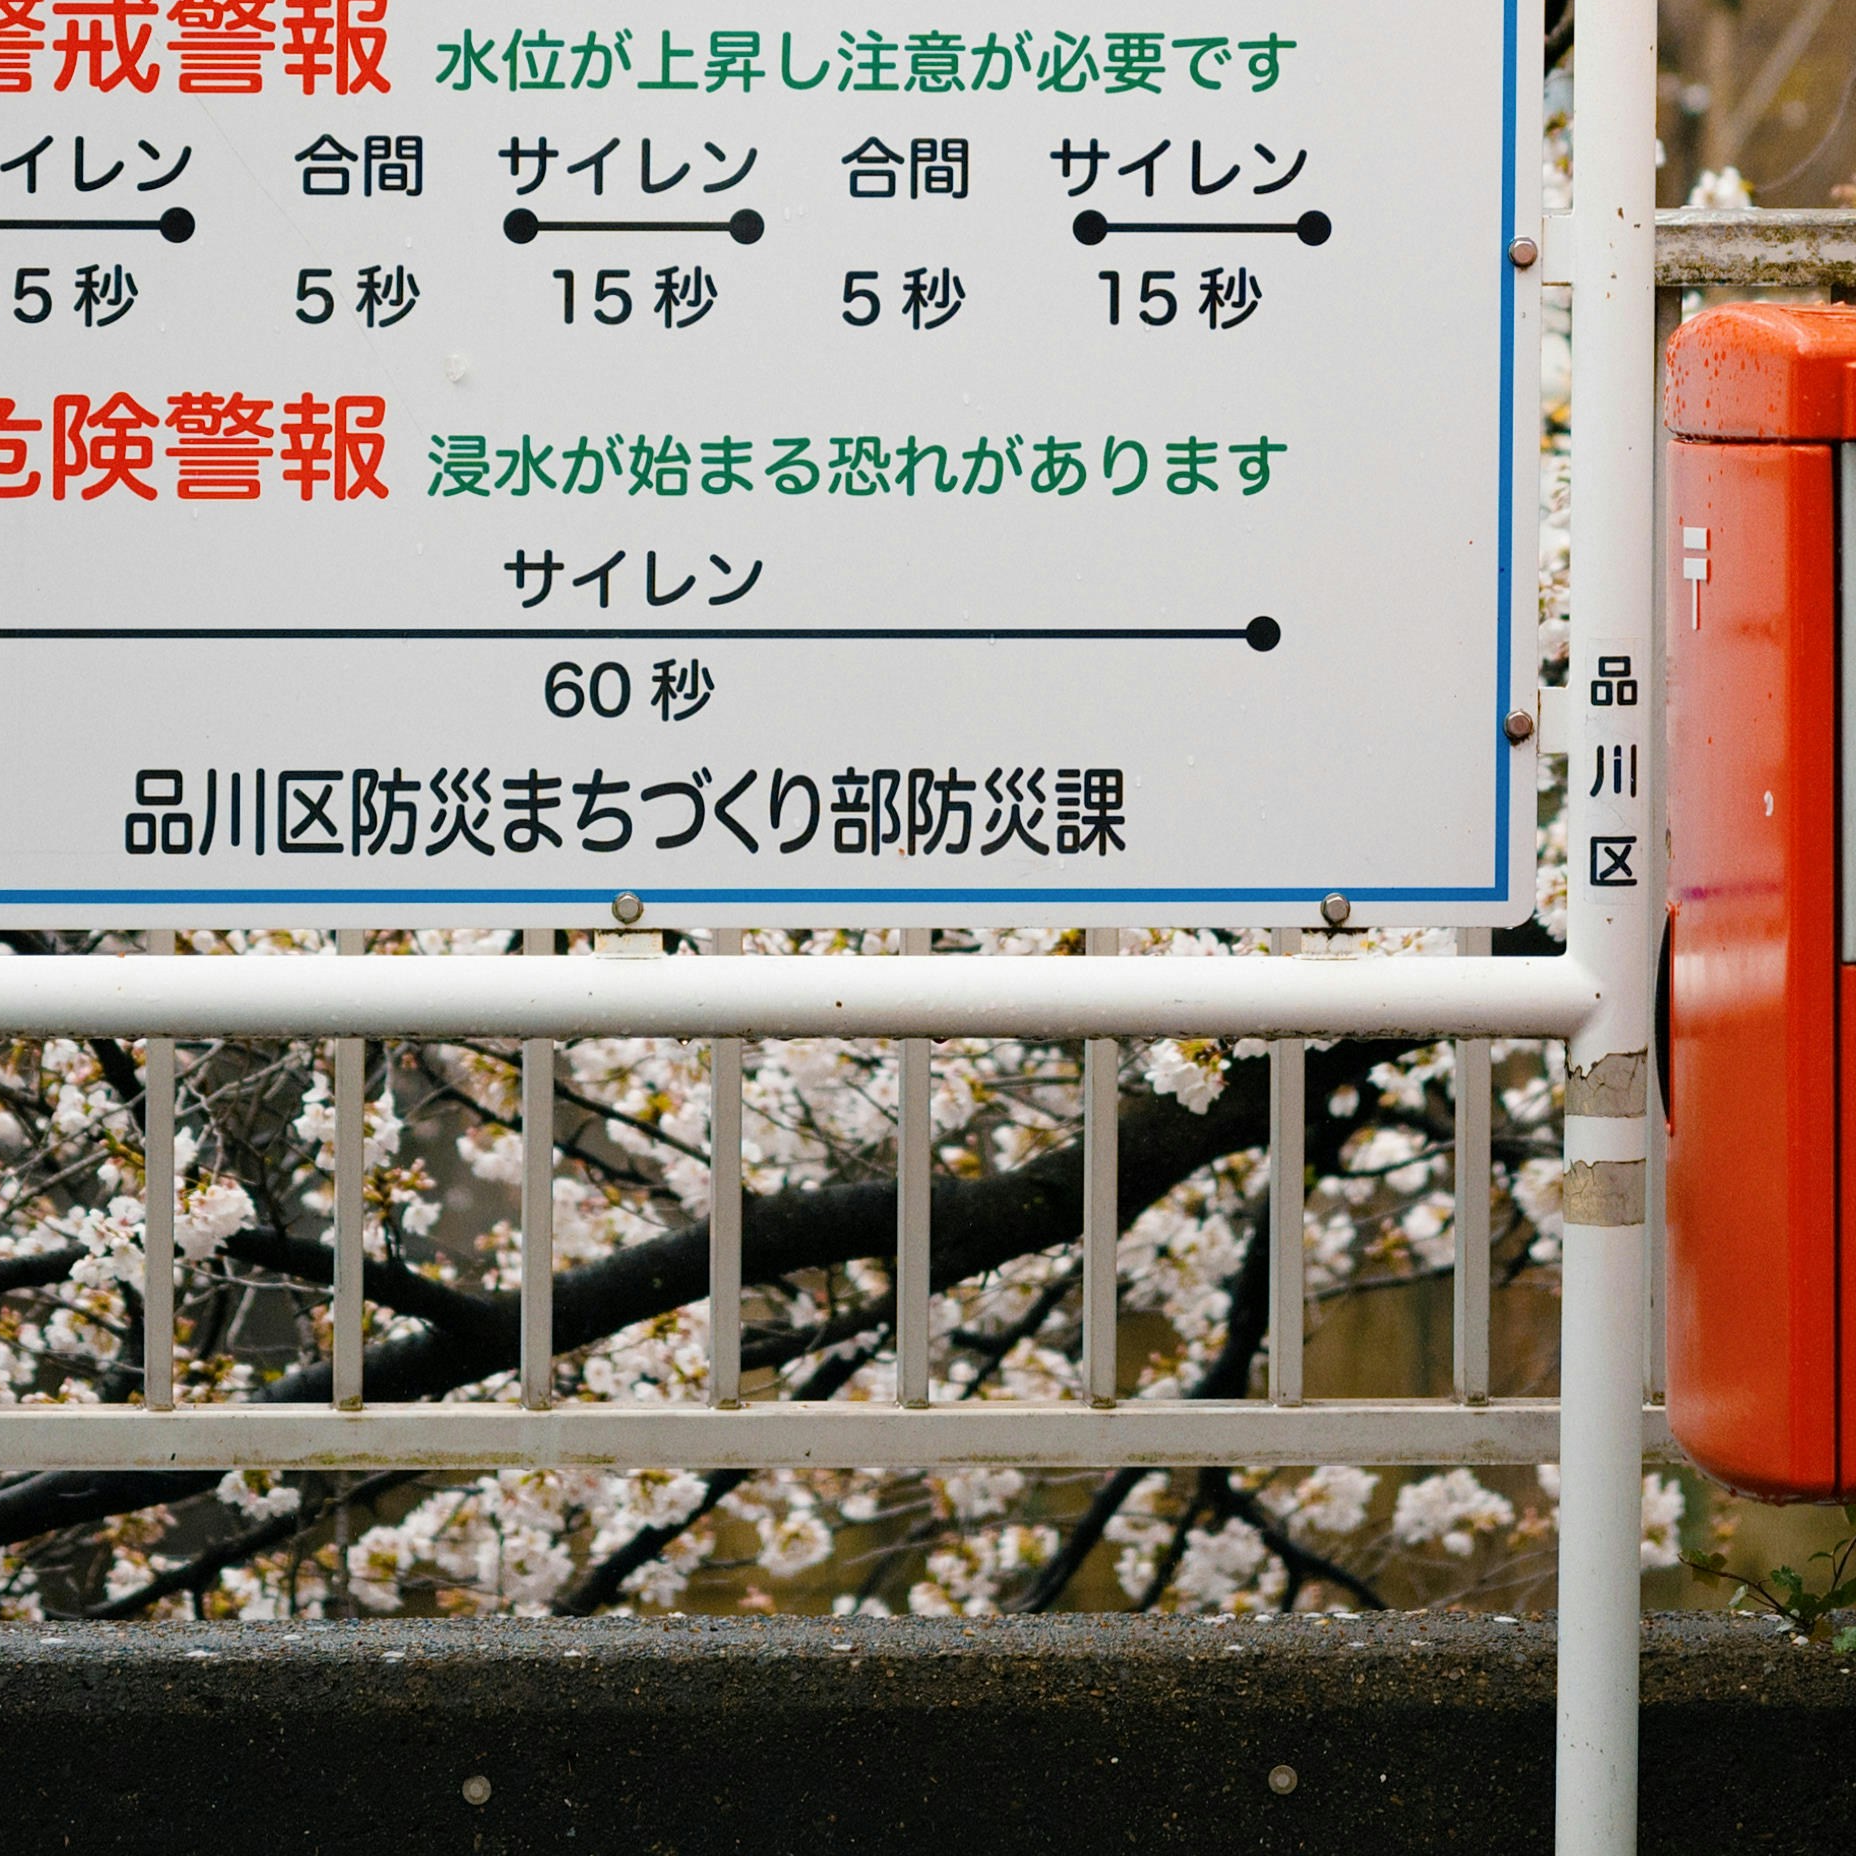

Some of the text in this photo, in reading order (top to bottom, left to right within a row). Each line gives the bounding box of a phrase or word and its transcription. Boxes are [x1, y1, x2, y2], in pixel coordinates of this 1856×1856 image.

[435, 27, 1298, 95] 水位が上昇し注意が必要です
[294, 133, 424, 198] 合間
[497, 135, 758, 197] サイレン
[840, 135, 970, 201] 合間
[1049, 137, 1308, 198] サイレン
[427, 432, 1289, 498] 浸水が始まる恐れがあります
[503, 548, 764, 609] サイレン
[1590, 656, 1637, 886] 品川区
[124, 765, 1127, 858] 品川区防災まちづくり部防災課
